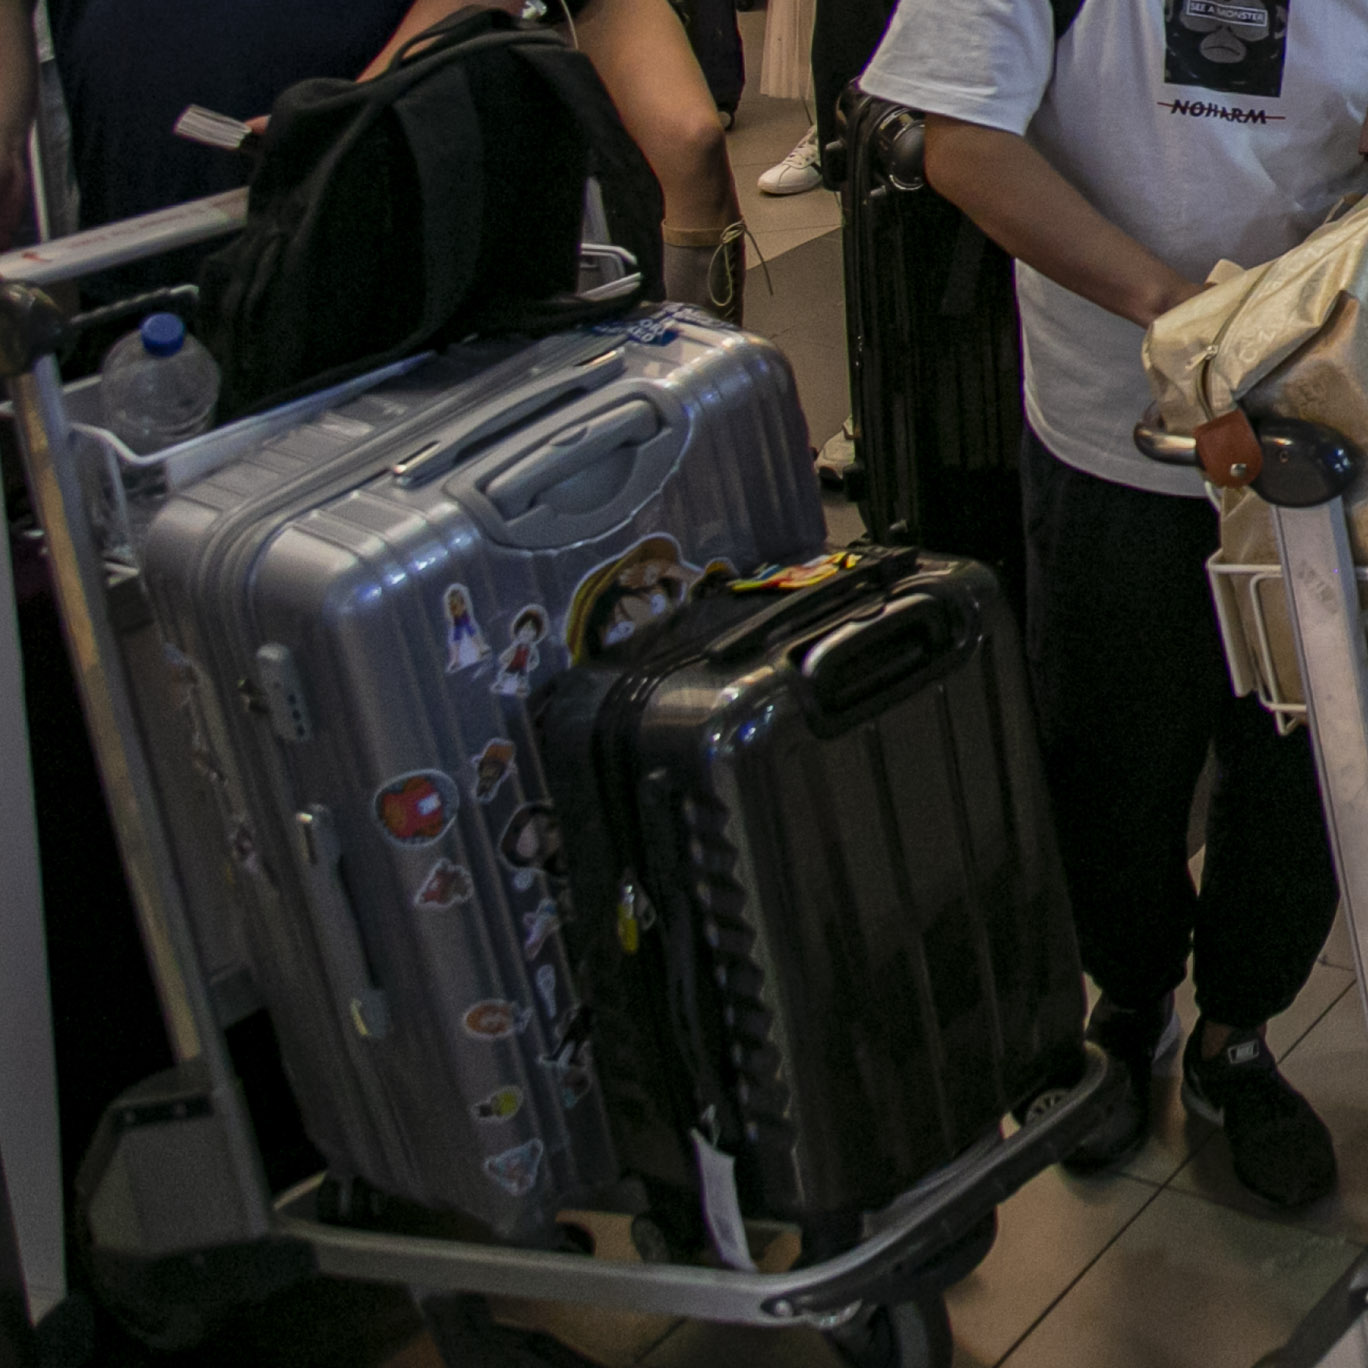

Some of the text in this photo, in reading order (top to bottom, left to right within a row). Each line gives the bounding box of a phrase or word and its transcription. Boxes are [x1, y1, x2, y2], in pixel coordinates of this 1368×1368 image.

[1189, 0, 1266, 22] SEE A MONSTER
